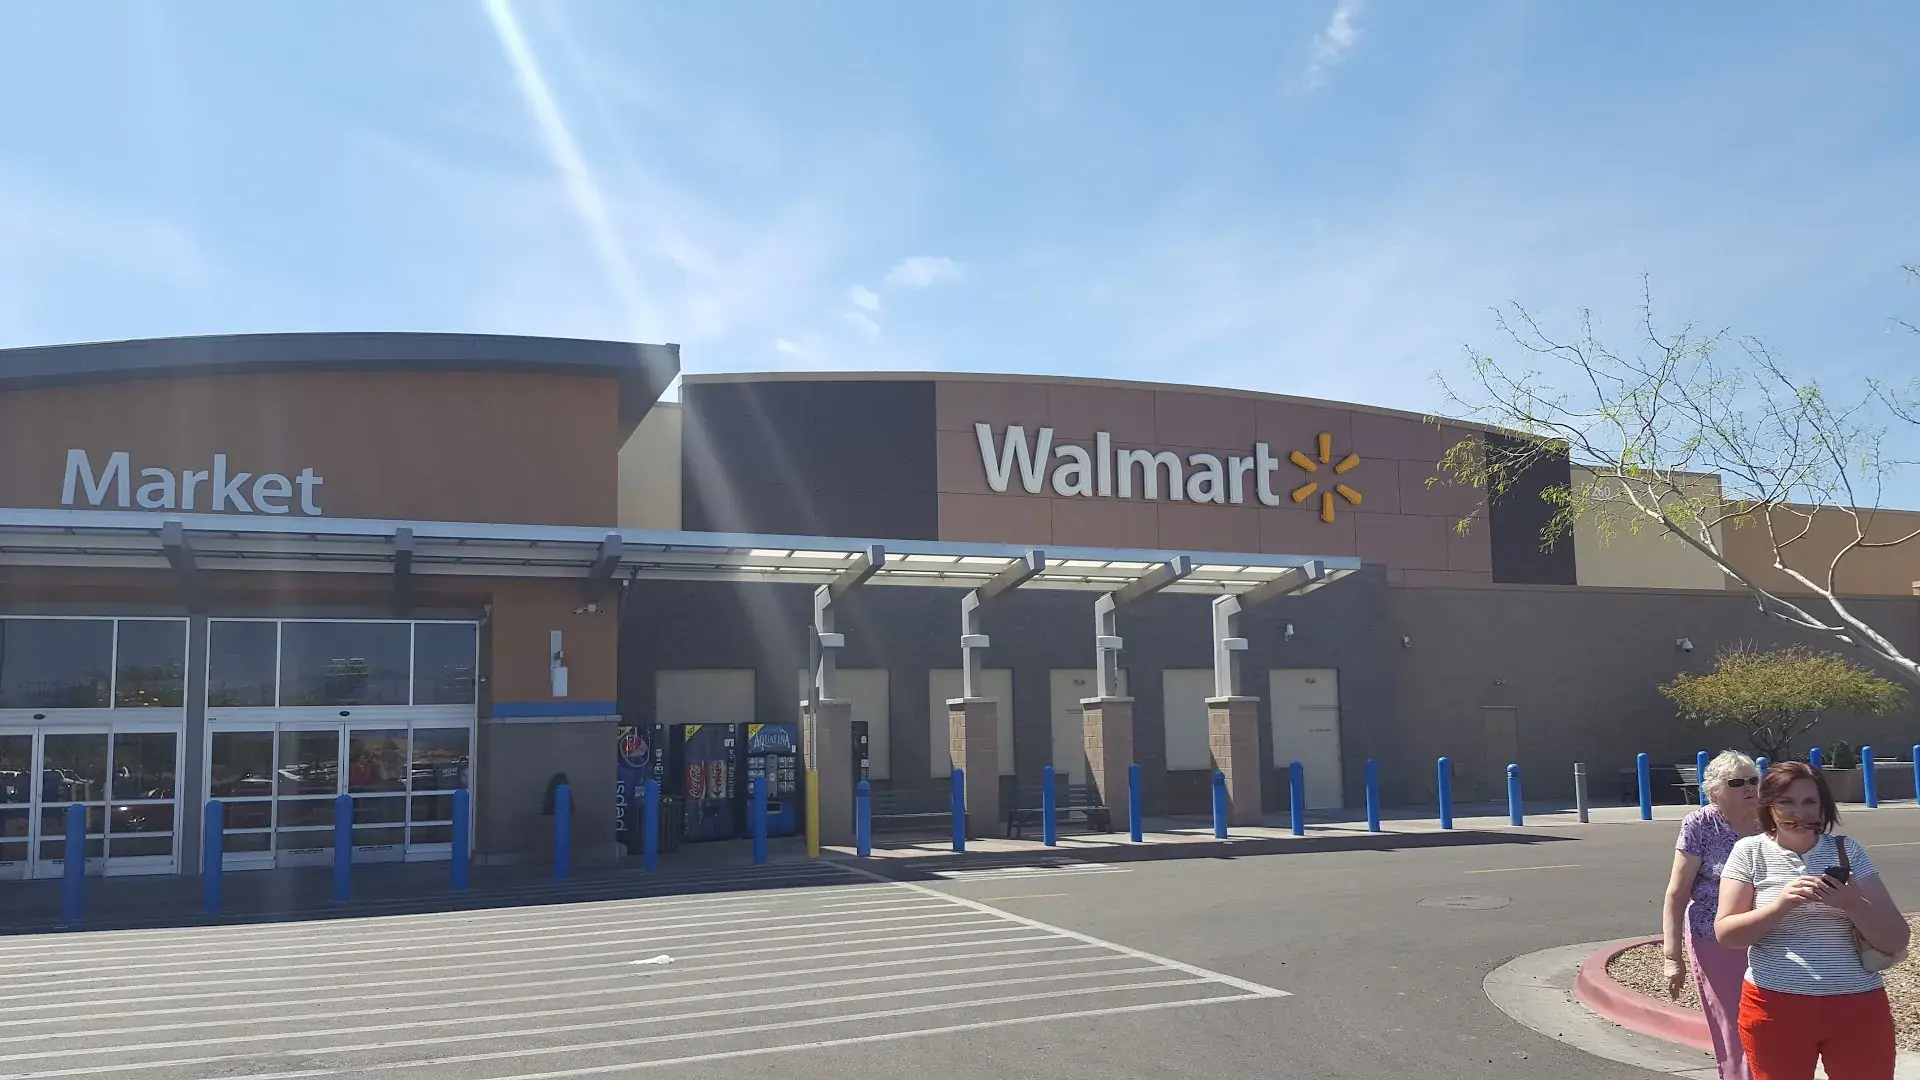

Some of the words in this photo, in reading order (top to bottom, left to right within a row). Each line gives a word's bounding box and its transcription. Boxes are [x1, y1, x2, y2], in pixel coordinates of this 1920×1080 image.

[61, 448, 324, 515] Market
[975, 422, 1280, 507] Walmart
[754, 732, 791, 750] AQUAFINA
[712, 764, 722, 795] Coke
[616, 780, 628, 831] pepsi
